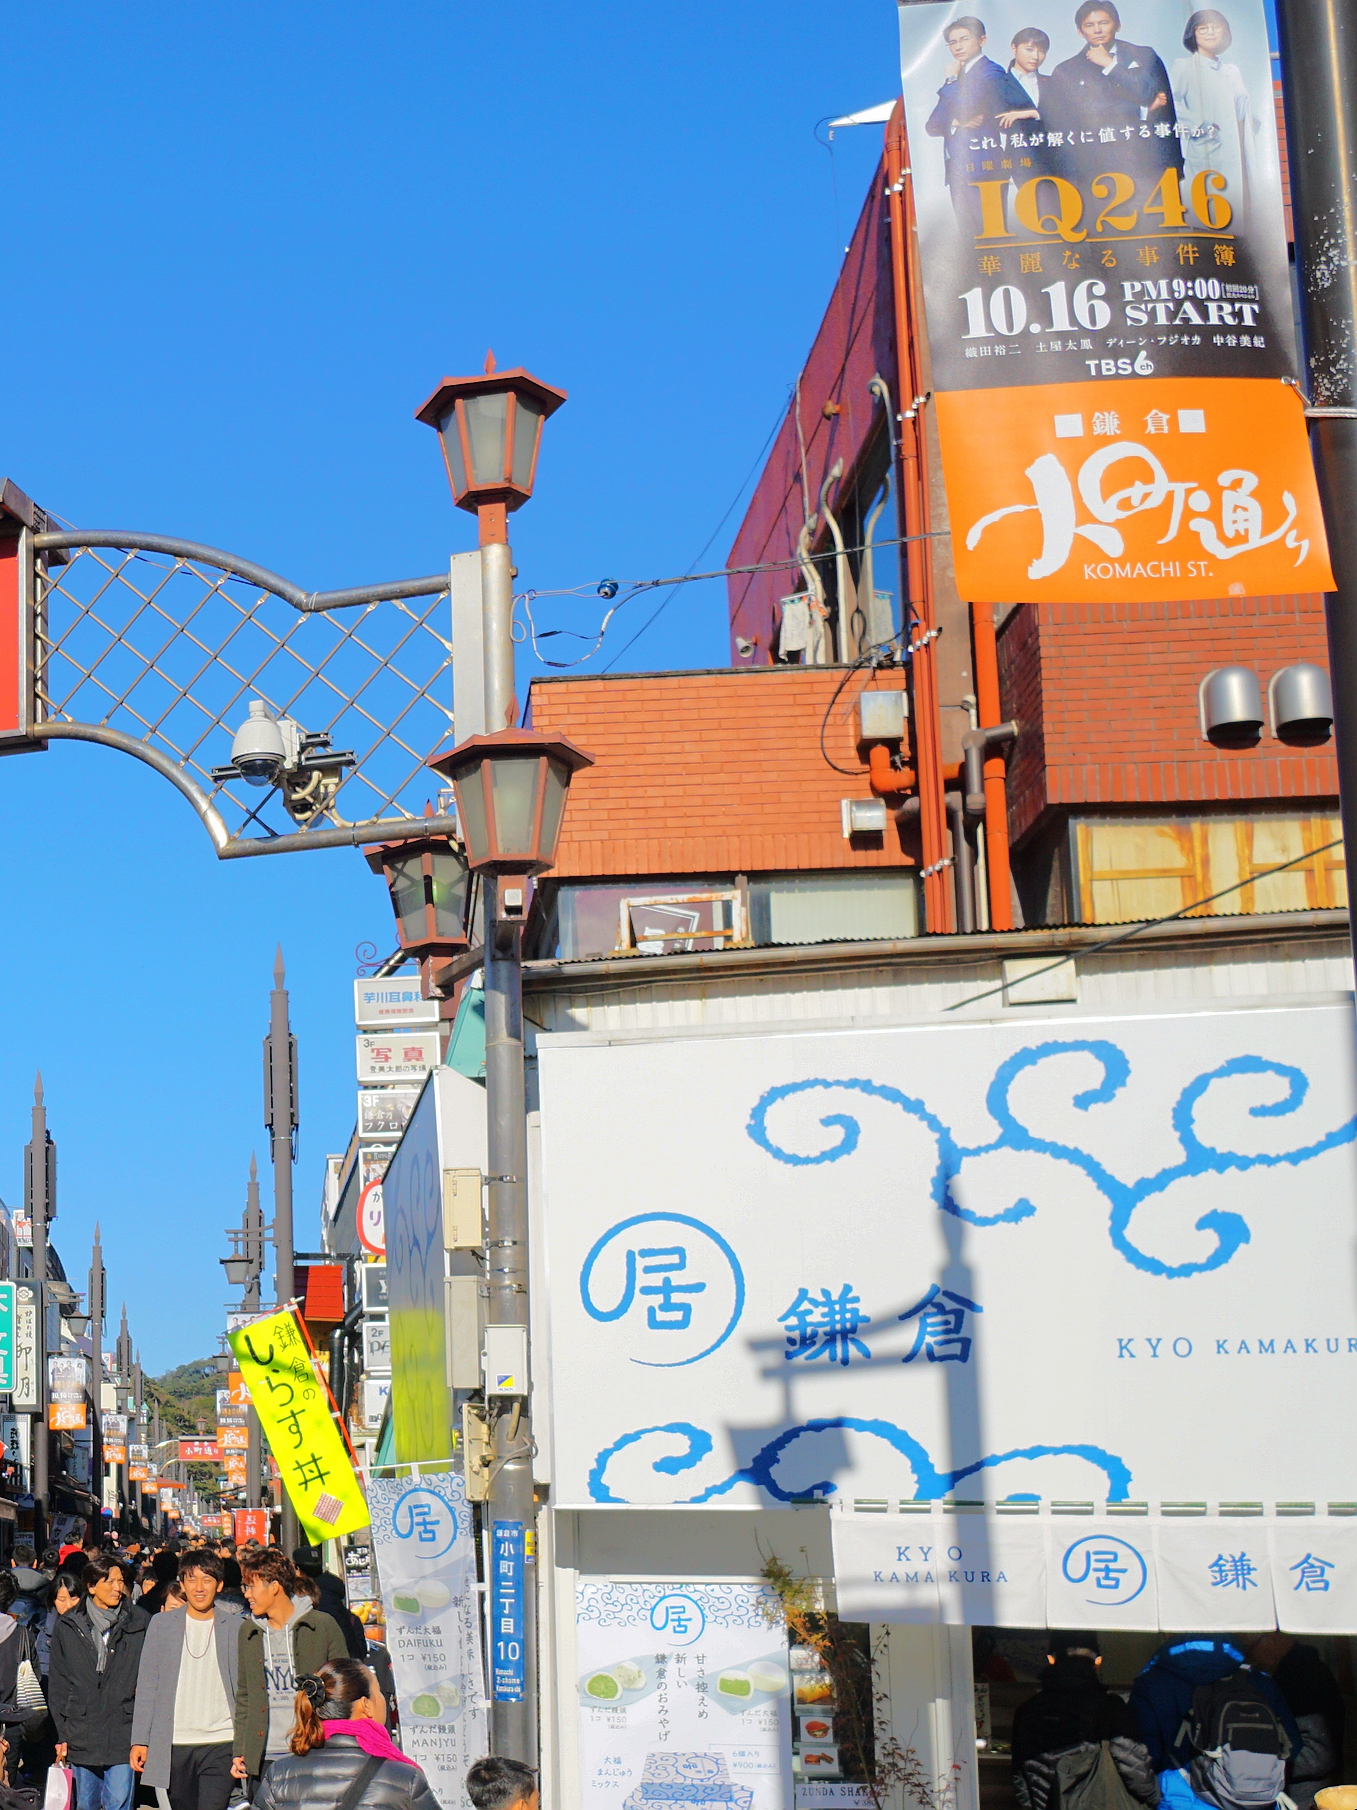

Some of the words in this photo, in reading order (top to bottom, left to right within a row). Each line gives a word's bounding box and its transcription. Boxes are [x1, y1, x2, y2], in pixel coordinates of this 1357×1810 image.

[968, 167, 1233, 243] IQ246
[977, 243, 1237, 276] 華麗なる事件簿
[958, 279, 1112, 339] 10.16
[1124, 301, 1260, 327] START
[964, 343, 1023, 358] 織田裕二
[1035, 338, 1094, 353] 土屋太鳳
[1212, 334, 1266, 349] 中谷美紀
[1091, 408, 1171, 436] 鎌倉
[965, 440, 1310, 581] 小町通り
[1083, 560, 1183, 581] KOMACHI
[1187, 560, 1214, 578] ST.
[363, 1039, 376, 1048] 3F
[370, 1046, 424, 1064] 写真
[362, 1094, 380, 1108] 3F
[370, 1327, 384, 1338] 2F
[777, 1282, 982, 1367] 鎌倉
[1116, 1337, 1193, 1358] KYO
[895, 1545, 964, 1563] KYO
[1207, 1551, 1335, 1592] 鎌倉
[499, 1541, 516, 1634] 小町二丁目
[395, 1625, 442, 1636] ずんだ大福
[397, 1638, 444, 1648] DAIFUKU
[497, 1641, 520, 1660] 10
[674, 1653, 688, 1689] 新しい
[654, 1652, 671, 1742] 鎌倉のおみやげ
[694, 1653, 709, 1720] 甘さ控えめ
[411, 1738, 457, 1749] MANJYU
[603, 1756, 622, 1765] 大福
[597, 1768, 633, 1777] まんじゅう
[591, 1779, 620, 1789] ミックス
[801, 1787, 835, 1796] ZUNDA
